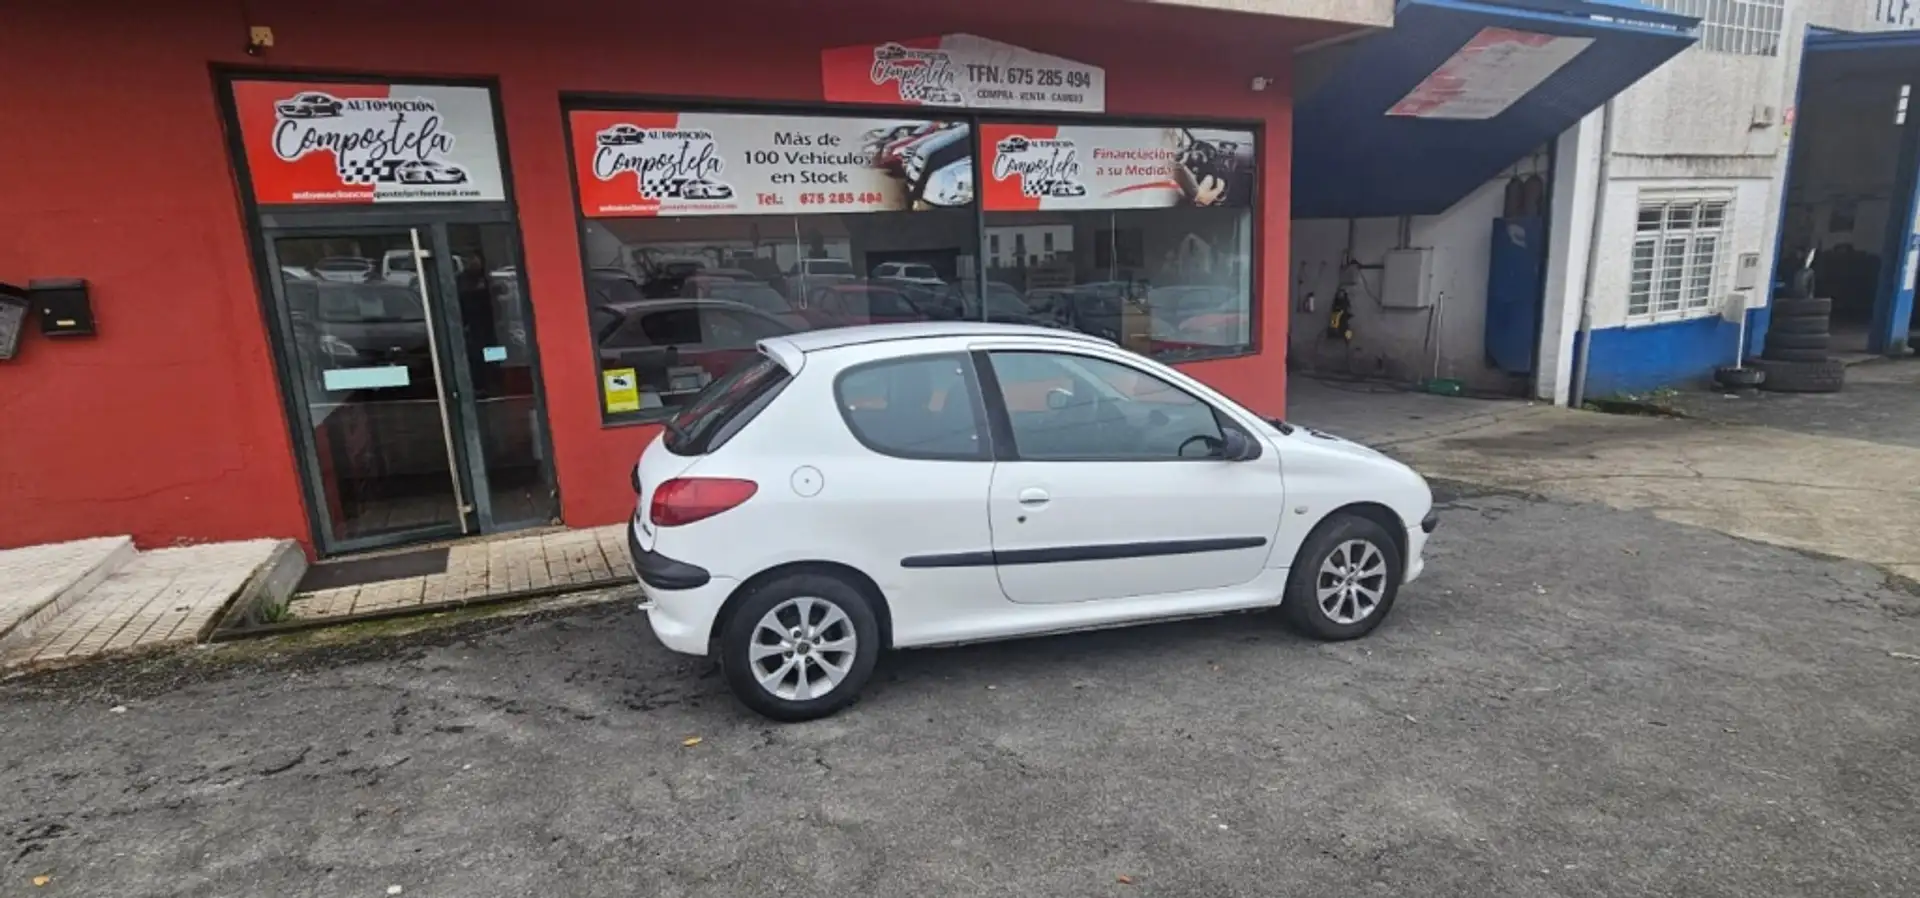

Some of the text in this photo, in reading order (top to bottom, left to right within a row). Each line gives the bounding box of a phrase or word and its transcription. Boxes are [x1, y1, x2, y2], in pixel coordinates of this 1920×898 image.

[967, 64, 1091, 88] TFN. 675 285 494
[977, 90, 1014, 100] COMPRA
[1020, 91, 1045, 102] VENTA
[346, 98, 435, 112] AUTOMOCIÓN
[276, 113, 453, 167] Compostela
[774, 132, 841, 146] Más de
[744, 150, 780, 164] 100
[1093, 147, 1174, 160] Financiación
[596, 140, 723, 190] Compostela
[994, 148, 1079, 181] Compostela
[1096, 164, 1172, 176] a su Medida
[771, 170, 848, 184] en Stock
[757, 192, 882, 205] Tel.: 675 285 494
